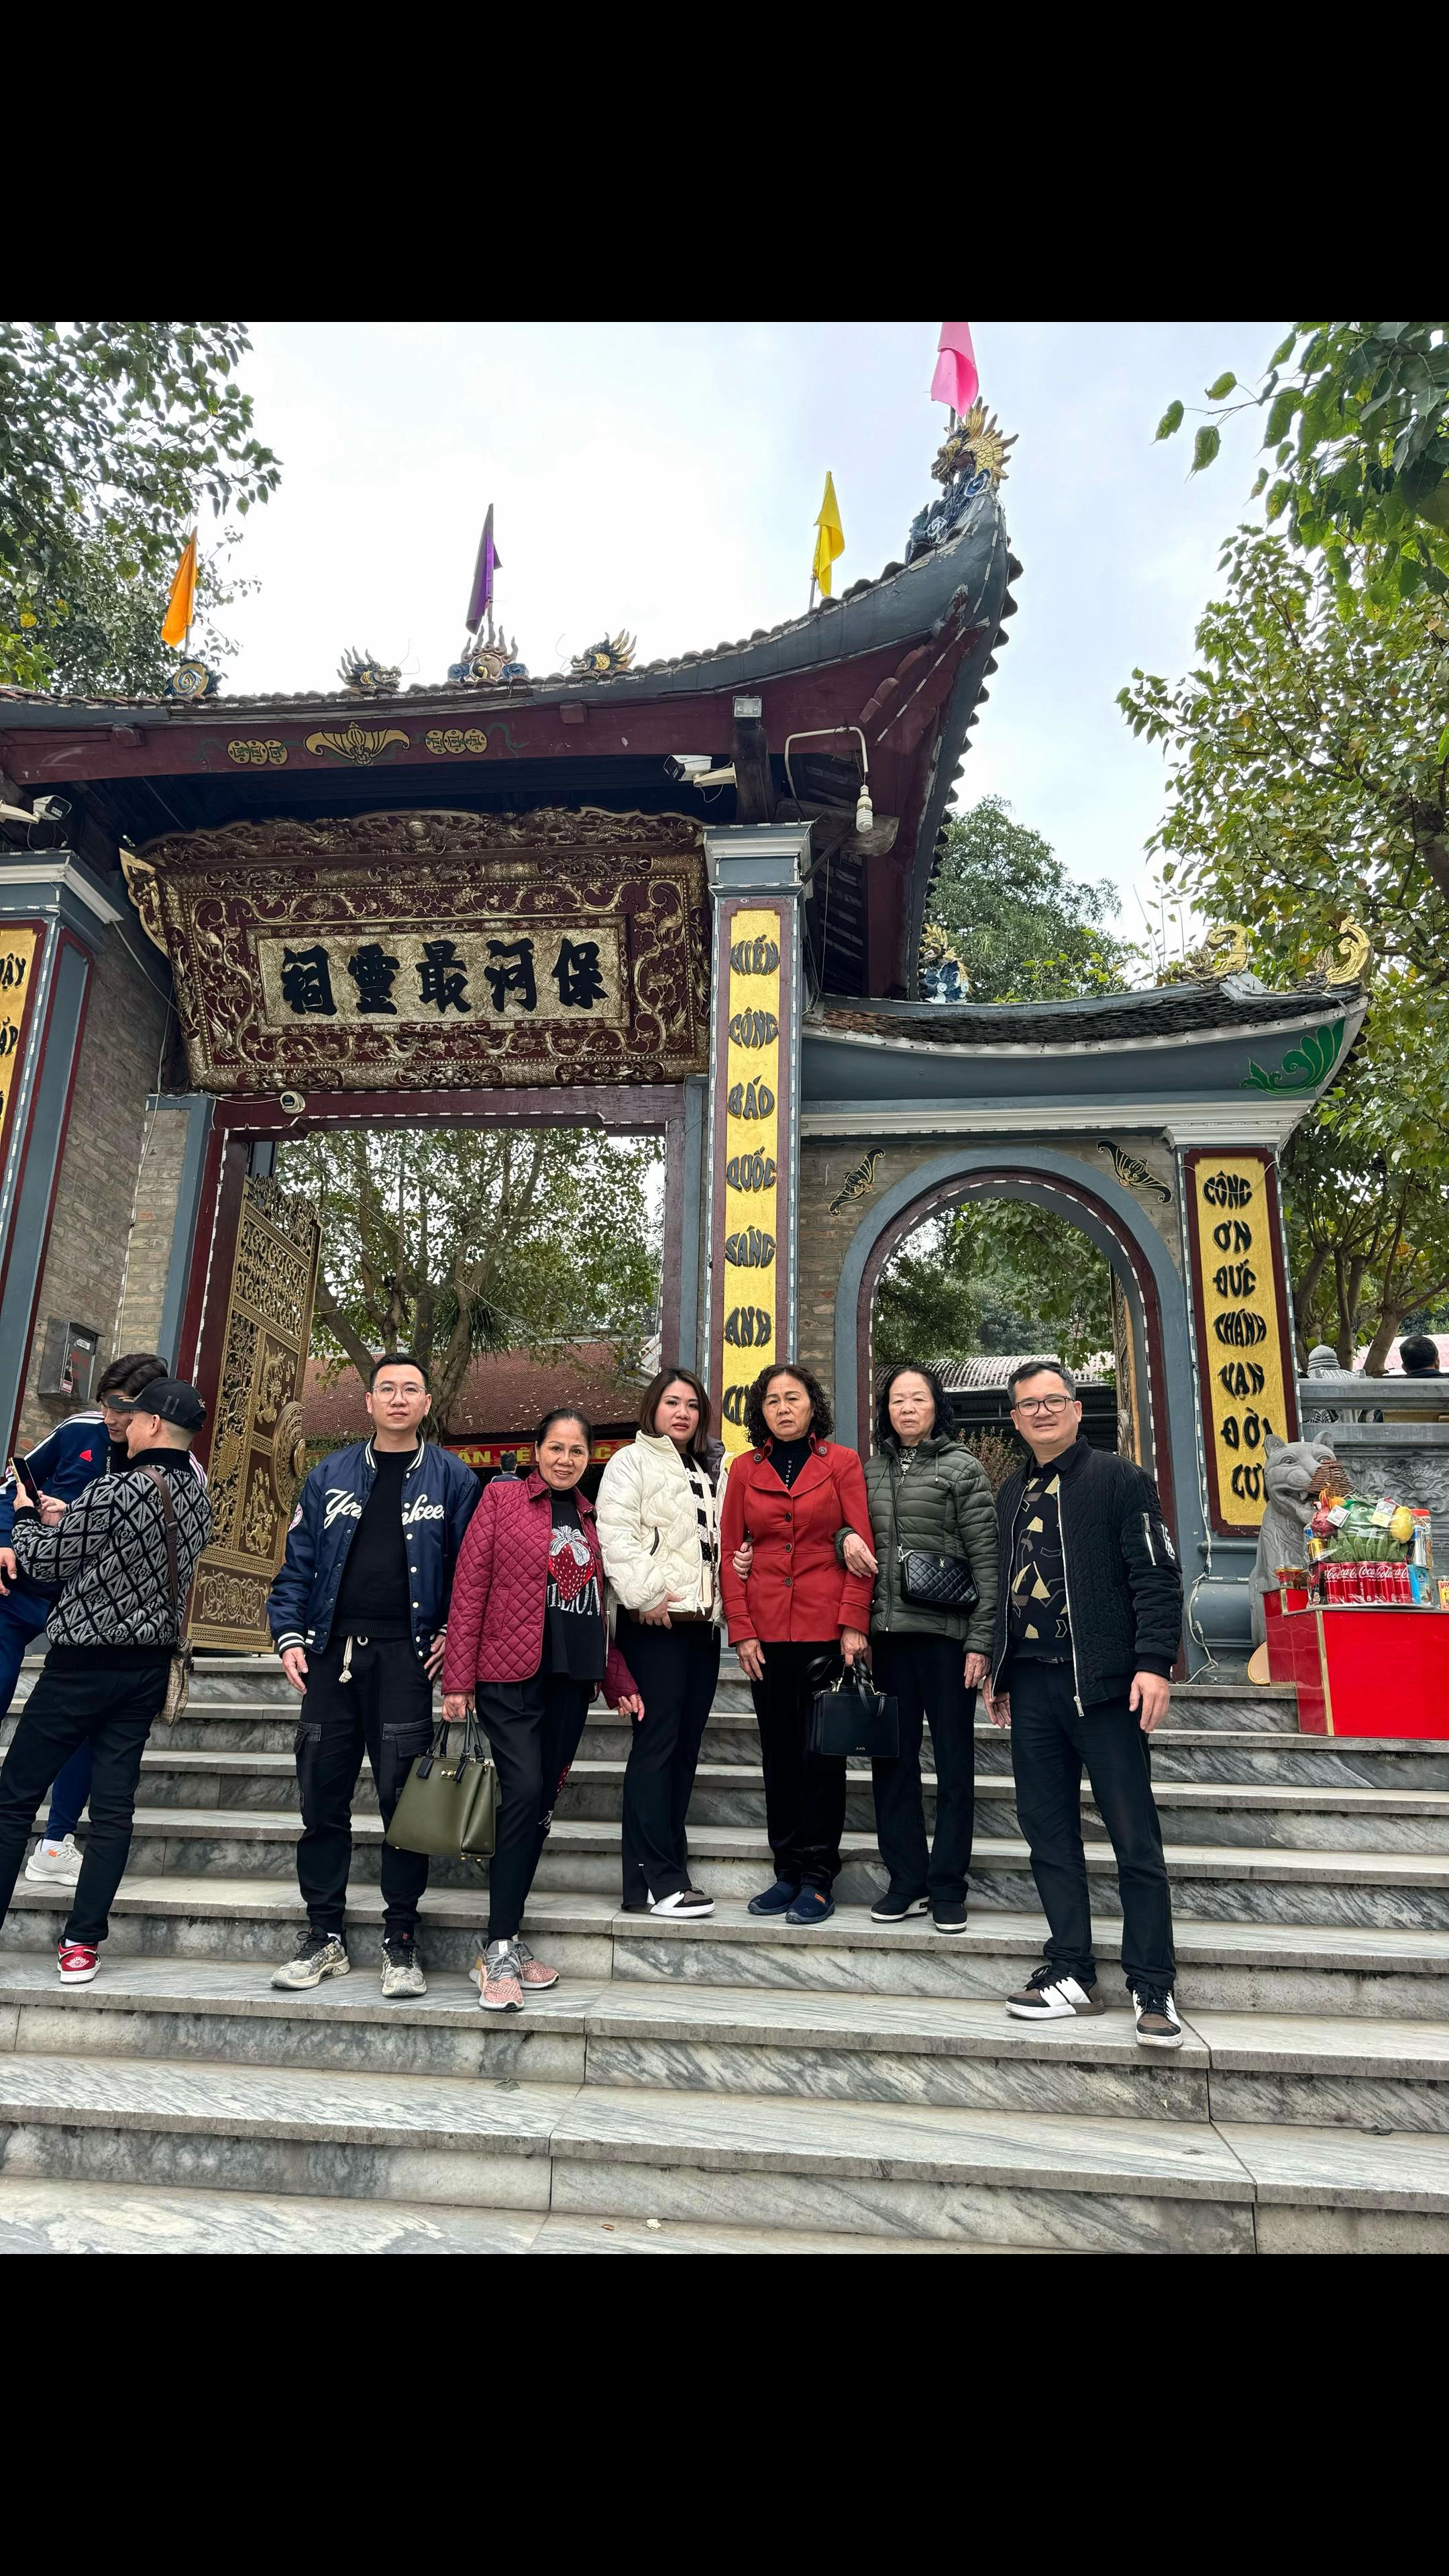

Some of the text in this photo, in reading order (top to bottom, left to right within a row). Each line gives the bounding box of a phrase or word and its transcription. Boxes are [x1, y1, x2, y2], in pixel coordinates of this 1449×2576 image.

[729, 1007, 778, 1050] CÔNG
[727, 1146, 777, 1193] QUỐC
[1203, 1170, 1252, 1210] CÔNG
[725, 1225, 775, 1268] SÁNG
[1214, 1220, 1252, 1254] ƠN
[1213, 1258, 1256, 1299] ĐỨC
[725, 1307, 772, 1347] ANH
[1213, 1308, 1267, 1347] THÁNH
[1218, 1361, 1265, 1400] VẠN
[457, 1449, 491, 1464] ÂN
[147, 1494, 163, 1504] DIO
[194, 1504, 211, 1515] DIOR
[88, 1510, 109, 1531] DIOR
[127, 1566, 152, 1576] DIOR
[83, 1594, 110, 1605] DIOR
[143, 1601, 161, 1609] DIO
